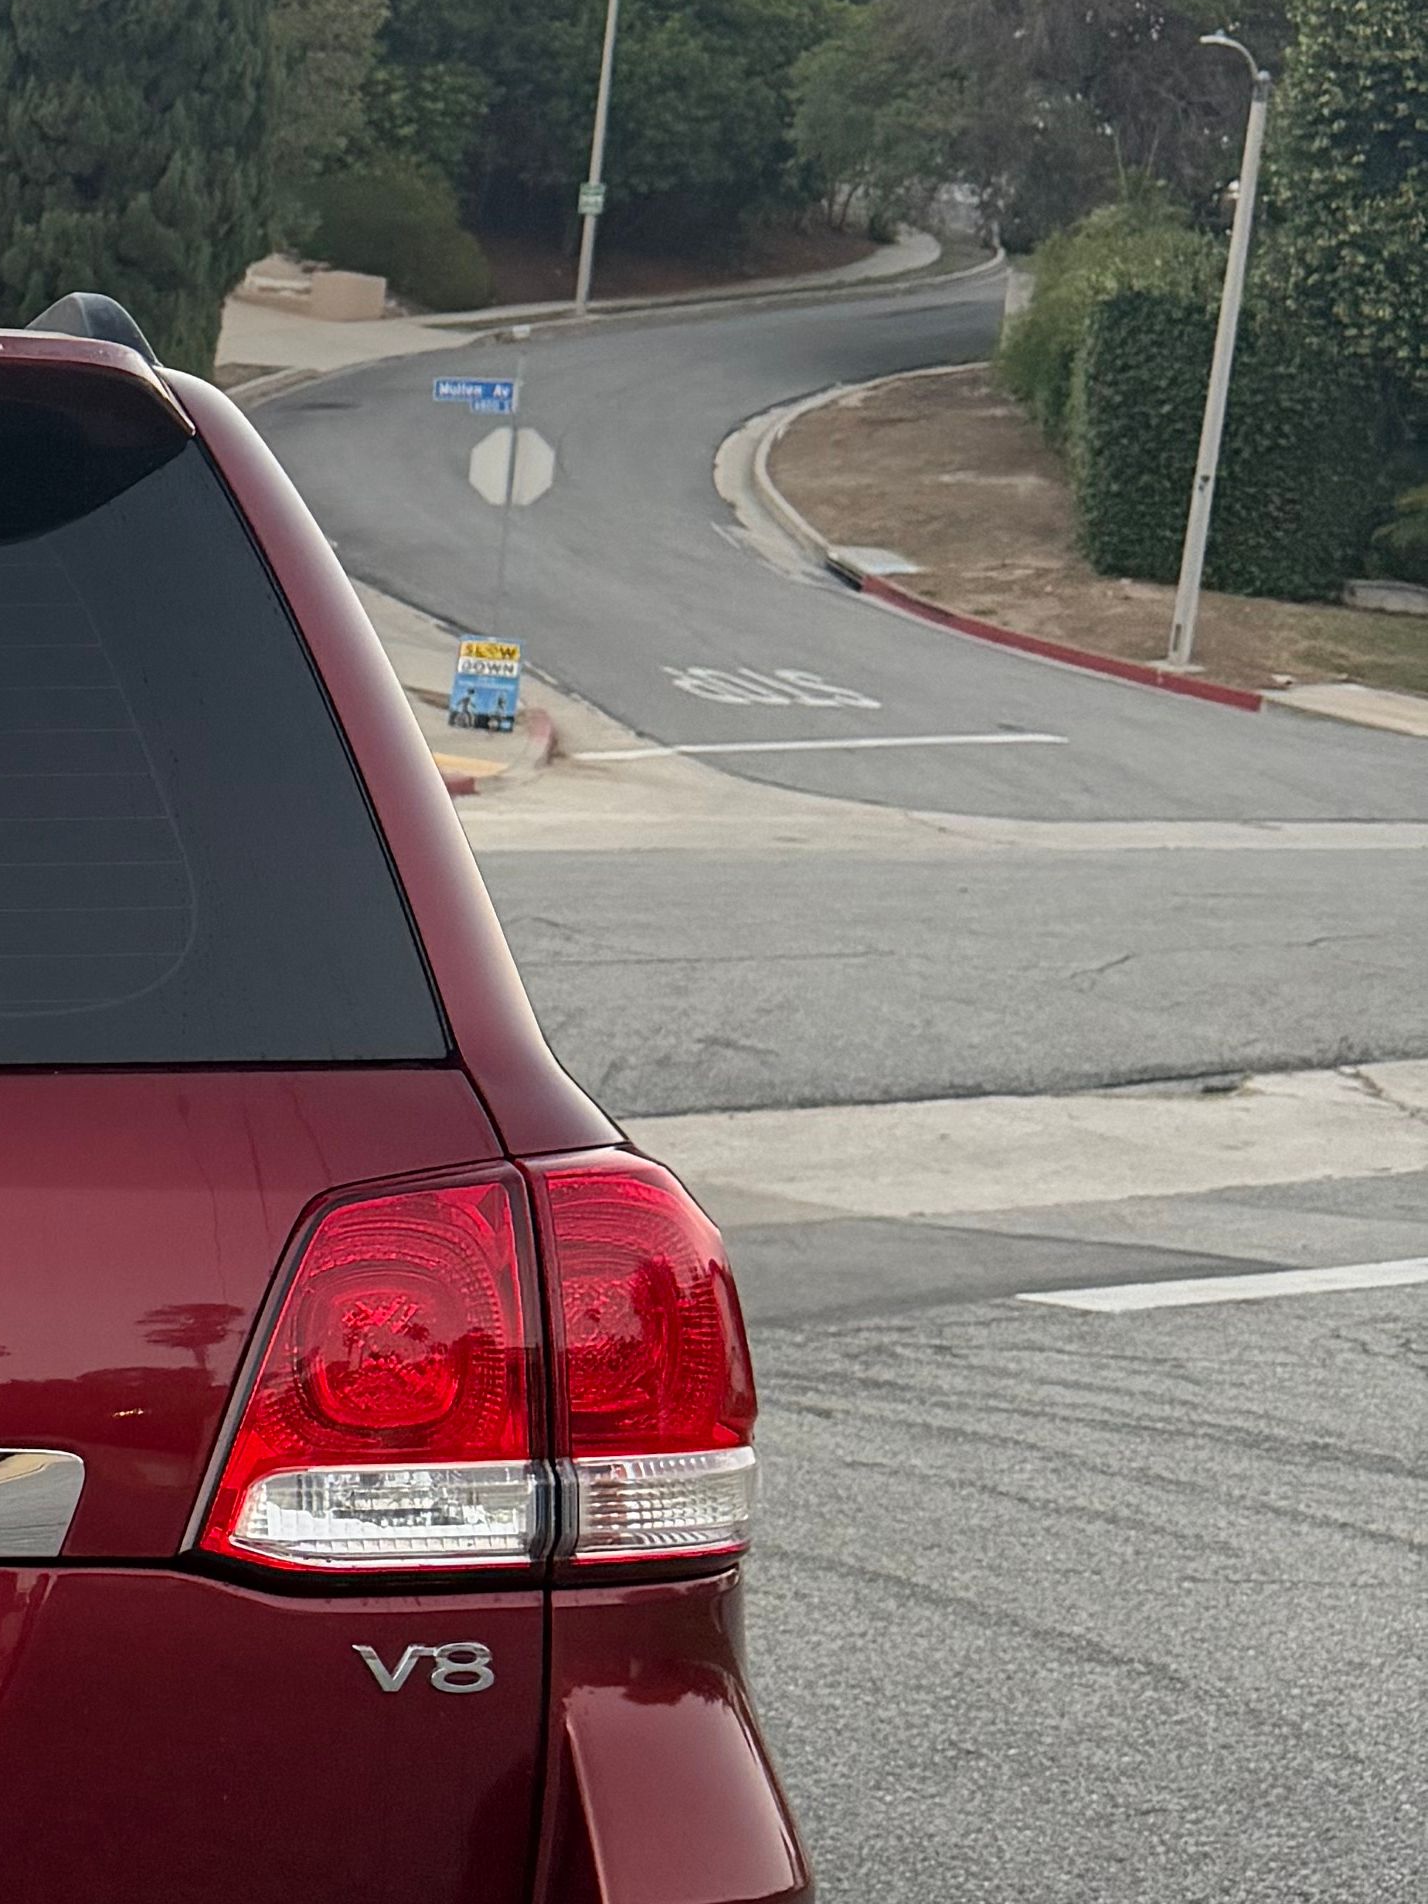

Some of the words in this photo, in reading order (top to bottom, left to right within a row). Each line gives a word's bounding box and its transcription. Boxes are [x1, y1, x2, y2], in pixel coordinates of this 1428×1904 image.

[466, 643, 518, 660] SLOW
[462, 660, 514, 674] DOWN
[351, 1642, 495, 1694] V8
